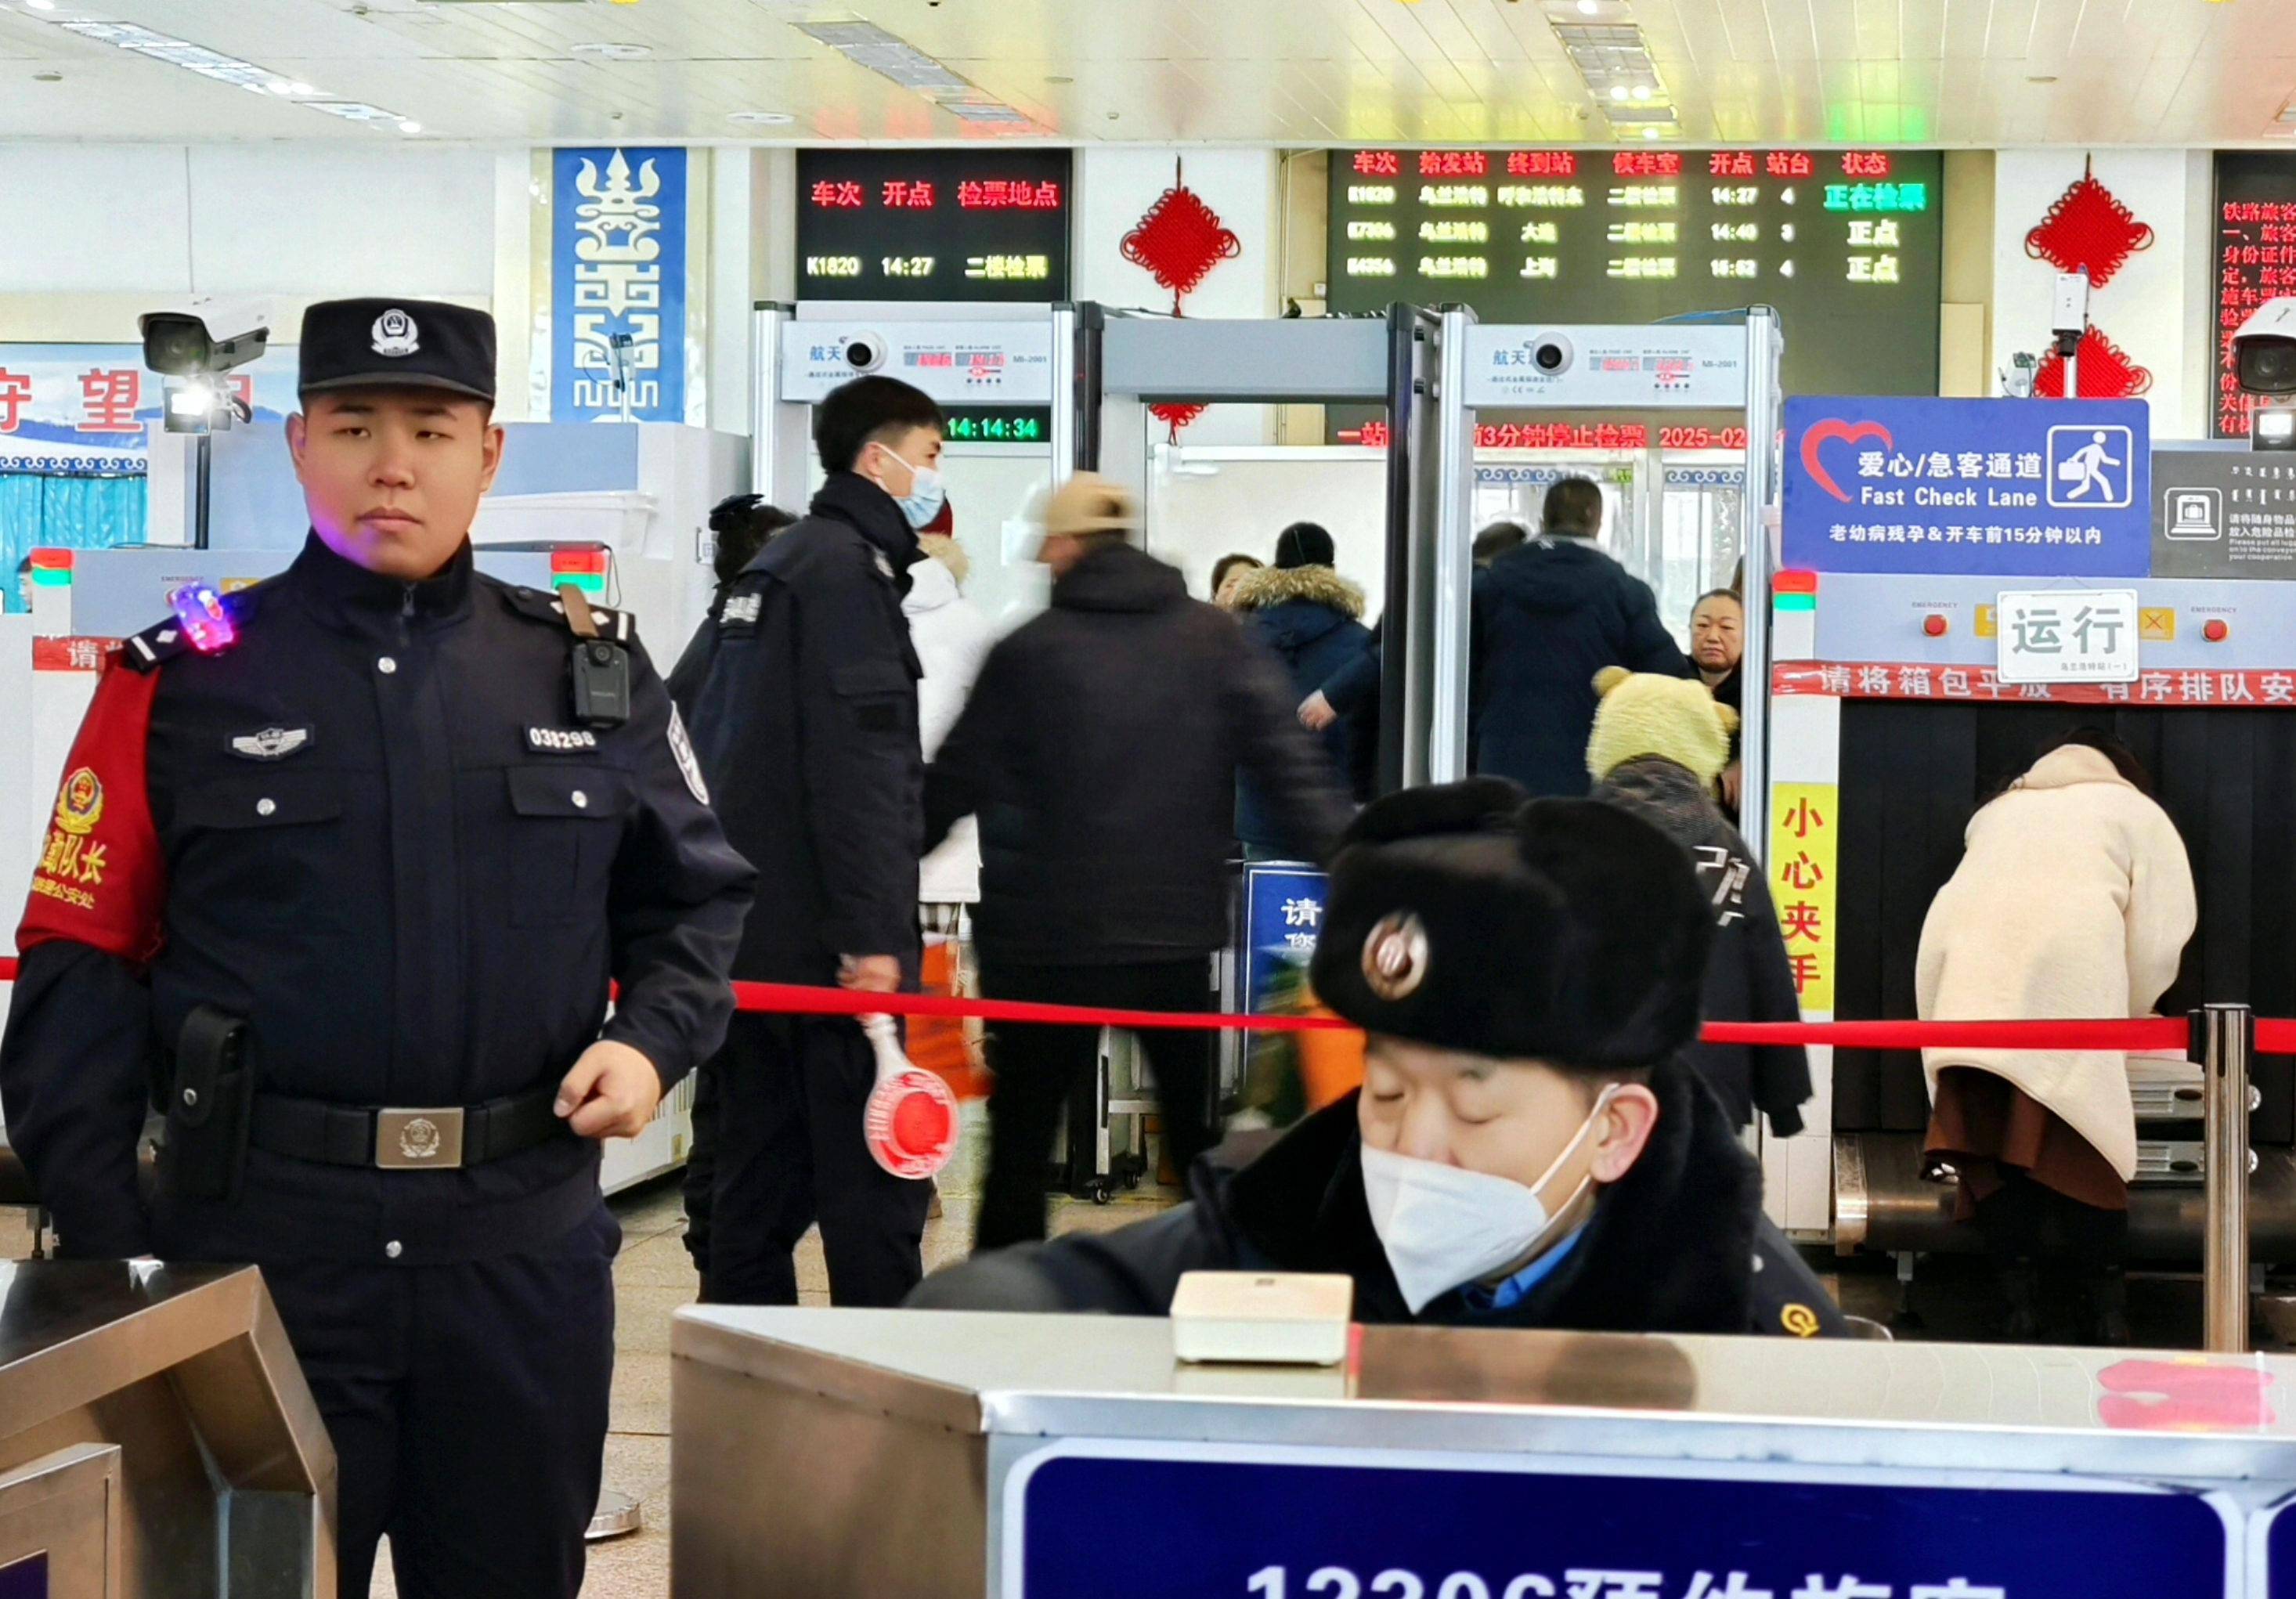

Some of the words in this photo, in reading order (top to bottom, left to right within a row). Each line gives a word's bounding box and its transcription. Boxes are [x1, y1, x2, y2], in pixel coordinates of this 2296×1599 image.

[1352, 152, 1397, 174] 车次
[1418, 151, 1485, 174] 始发站
[1507, 152, 1573, 174] 终到站
[1709, 153, 1753, 175] 开点
[1767, 154, 1810, 175] 站台
[1843, 153, 1887, 175] 状态
[811, 181, 861, 206] 车次
[883, 181, 932, 206] 开点
[957, 181, 1057, 207] 检票地点
[1781, 188, 1796, 205] 4
[1825, 184, 1926, 211] 正在检票
[1847, 220, 1900, 247] 正点
[807, 257, 860, 276] K1820
[882, 257, 934, 276] 14:27
[964, 255, 1049, 278] 二楼检票
[1779, 260, 1795, 278] 4
[1847, 255, 1900, 283] 正点
[1493, 350, 1532, 366] 航天
[948, 418, 1038, 438] 14:14:34
[1475, 423, 1644, 447] 3分钟停止检票
[1858, 451, 2041, 478] 爱心/急客通道
[1861, 487, 1904, 505] Fast
[1915, 487, 1977, 506] Check
[1988, 489, 2037, 507] Lane
[1829, 524, 2102, 545] 老幼病残孕&开车前15分钟以内
[2012, 606, 2125, 655] 运行
[1781, 797, 1824, 994] 小心夹手
